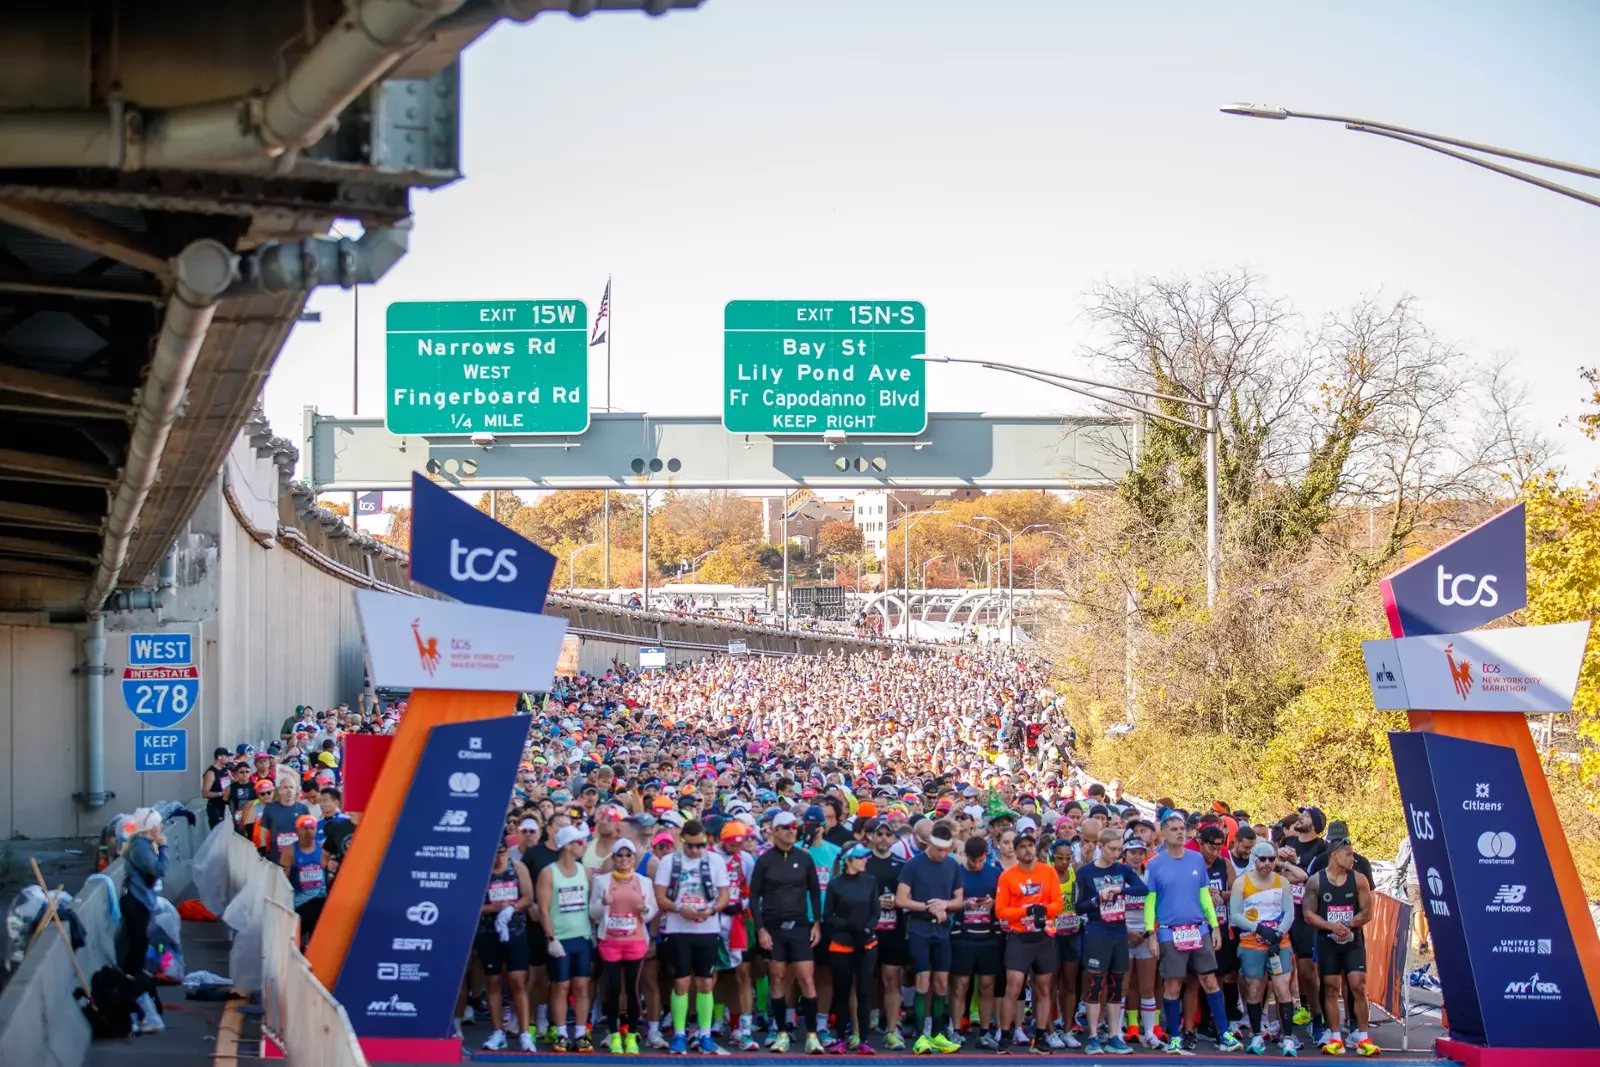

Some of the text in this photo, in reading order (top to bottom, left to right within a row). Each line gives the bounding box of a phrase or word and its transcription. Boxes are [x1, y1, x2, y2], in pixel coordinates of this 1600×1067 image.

[480, 305, 576, 324] EXIT 15W
[797, 305, 915, 325] EXIT 15N-S
[418, 337, 556, 356] Narrows Rd
[783, 338, 867, 360] Bay St
[463, 364, 511, 379] WEST
[738, 363, 911, 385] Lily Pond Ave
[394, 386, 580, 410] Fingerboard Rd
[730, 389, 920, 410] Fr Capodanno Blvd
[484, 413, 524, 427] MILE
[773, 414, 876, 428] KEEP RIGHT
[359, 500, 375, 511] tcs
[449, 538, 518, 583] tcs
[1437, 564, 1498, 608] tcs
[135, 639, 187, 659] WEST
[451, 638, 471, 650] tcs
[131, 669, 191, 678] INTERSTATE
[1482, 662, 1501, 674] tcs
[1482, 676, 1500, 684] NEW
[1524, 677, 1541, 685] CITY
[1482, 685, 1527, 693] MARATHON
[136, 684, 188, 713] 278
[143, 735, 178, 748] KEEP
[145, 753, 177, 765] LEFT
[457, 750, 492, 760] Citizens
[1462, 800, 1502, 811] Citizens
[1410, 803, 1435, 841] tcs
[1430, 899, 1450, 917] TATA
[1501, 904, 1532, 913] balance
[1328, 912, 1353, 921] 29648
[392, 938, 433, 951] ESPN
